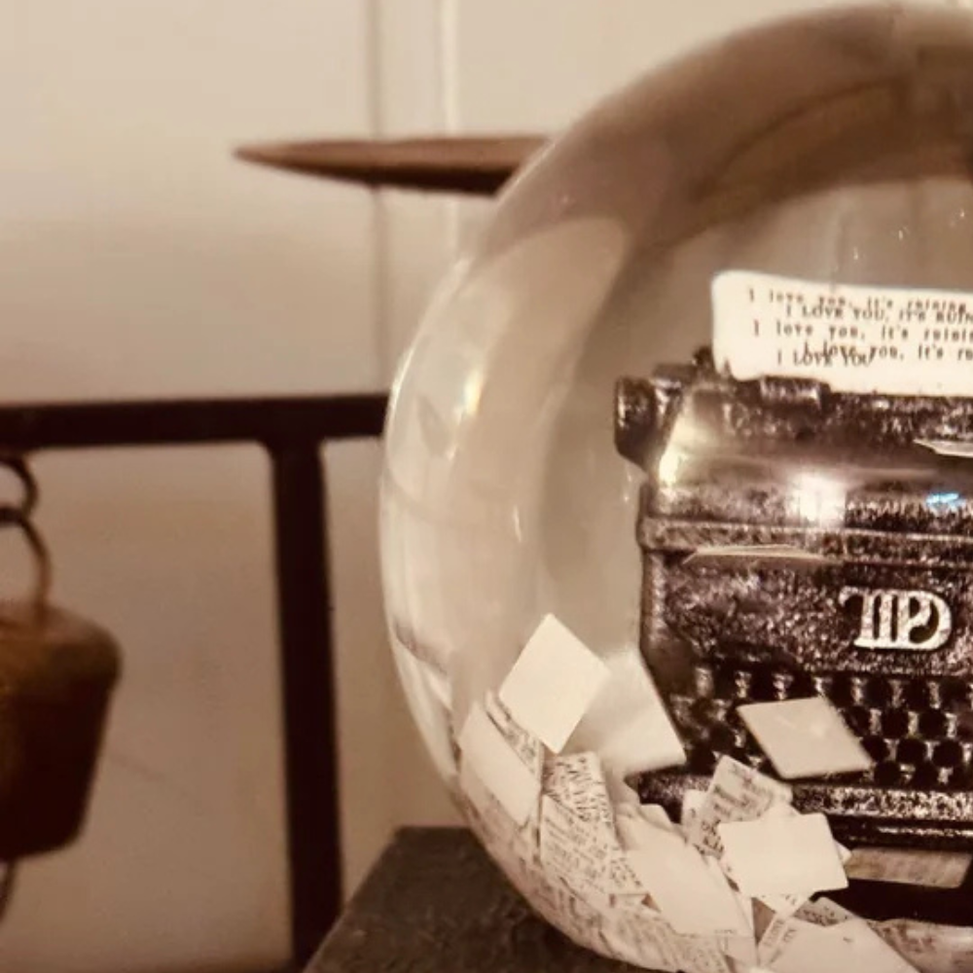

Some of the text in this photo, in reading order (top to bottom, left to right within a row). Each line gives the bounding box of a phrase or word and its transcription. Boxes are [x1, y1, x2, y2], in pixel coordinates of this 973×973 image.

[801, 304, 844, 319] LOVE
[776, 320, 815, 337] love
[828, 325, 866, 341] you,
[881, 324, 909, 341] it's
[918, 343, 944, 360] it's
